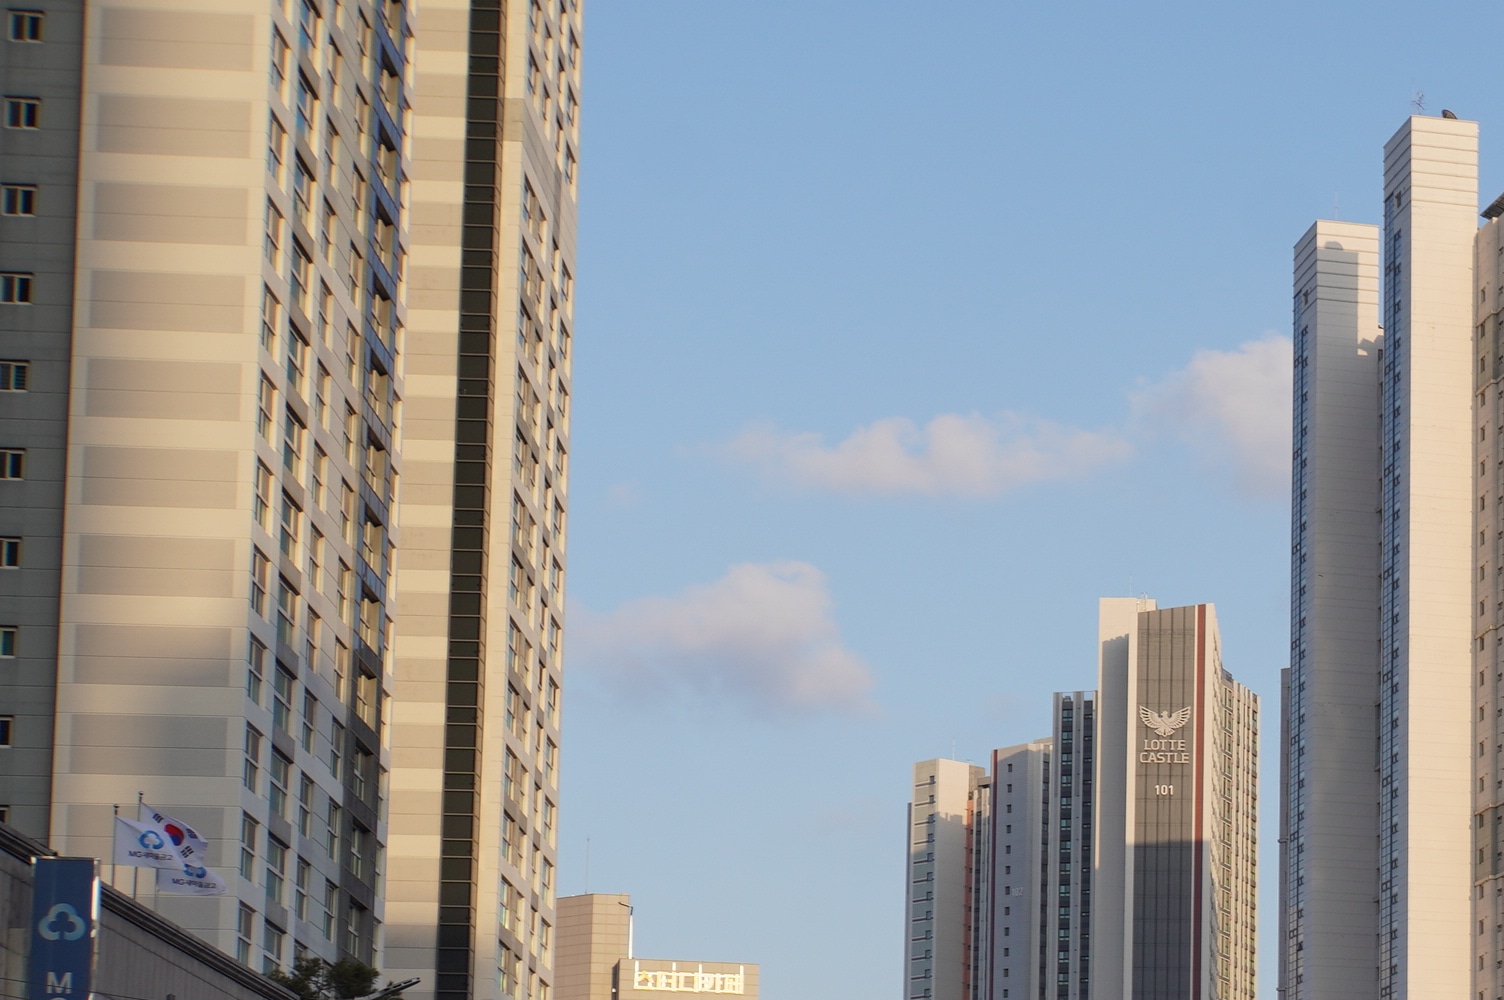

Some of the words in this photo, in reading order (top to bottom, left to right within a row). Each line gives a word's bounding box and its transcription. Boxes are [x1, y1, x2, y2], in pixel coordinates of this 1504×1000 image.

[1143, 739, 1186, 751] LOTTE
[1140, 752, 1190, 764] CASTLE
[1154, 784, 1174, 796] 101
